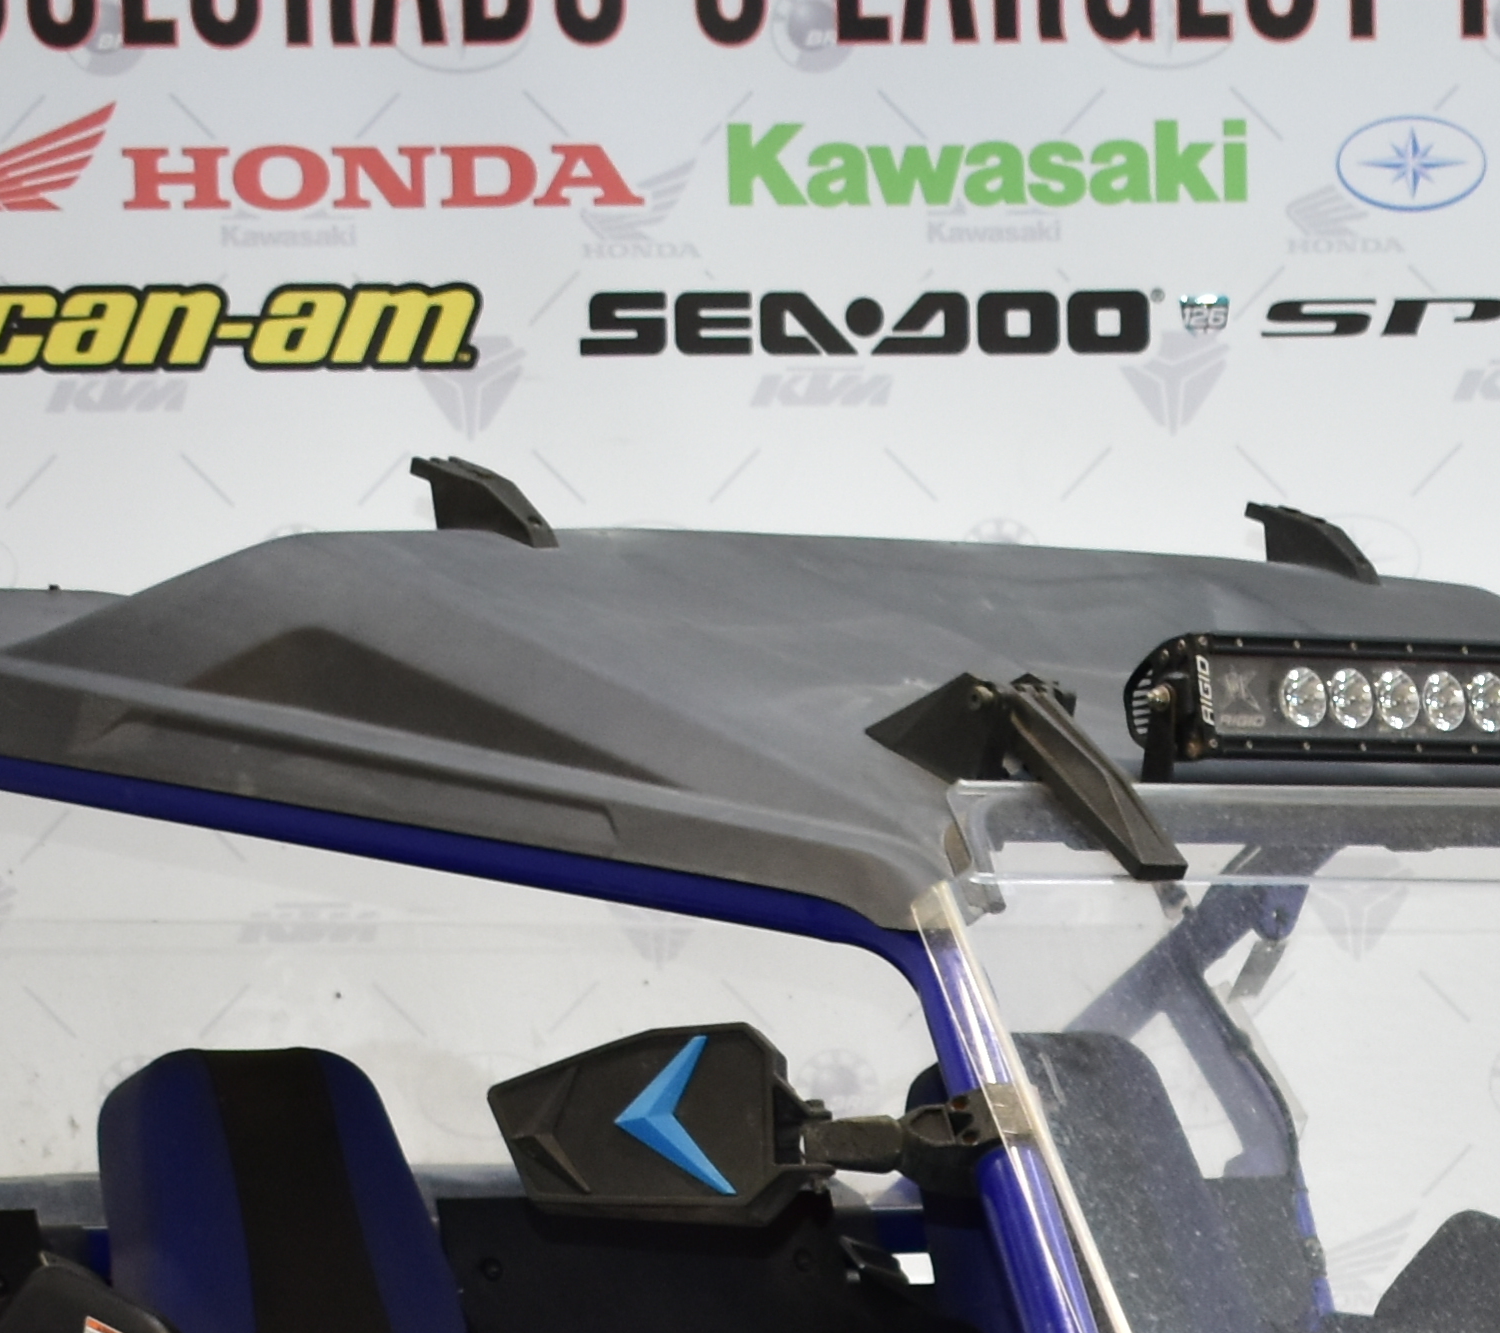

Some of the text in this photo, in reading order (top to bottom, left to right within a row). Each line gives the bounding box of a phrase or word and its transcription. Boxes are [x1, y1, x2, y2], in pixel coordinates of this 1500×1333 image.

[806, 29, 837, 46] BR
[120, 142, 645, 212] HONDA
[727, 119, 1247, 208] Kawasaki
[221, 221, 357, 248] Kawasaki
[928, 219, 1061, 245] Kawasaki
[1286, 237, 1405, 254] HONDA
[582, 242, 702, 260] HONDA
[46, 377, 185, 413] KTM
[751, 367, 890, 407] KTM
[1196, 655, 1215, 726] RIGID
